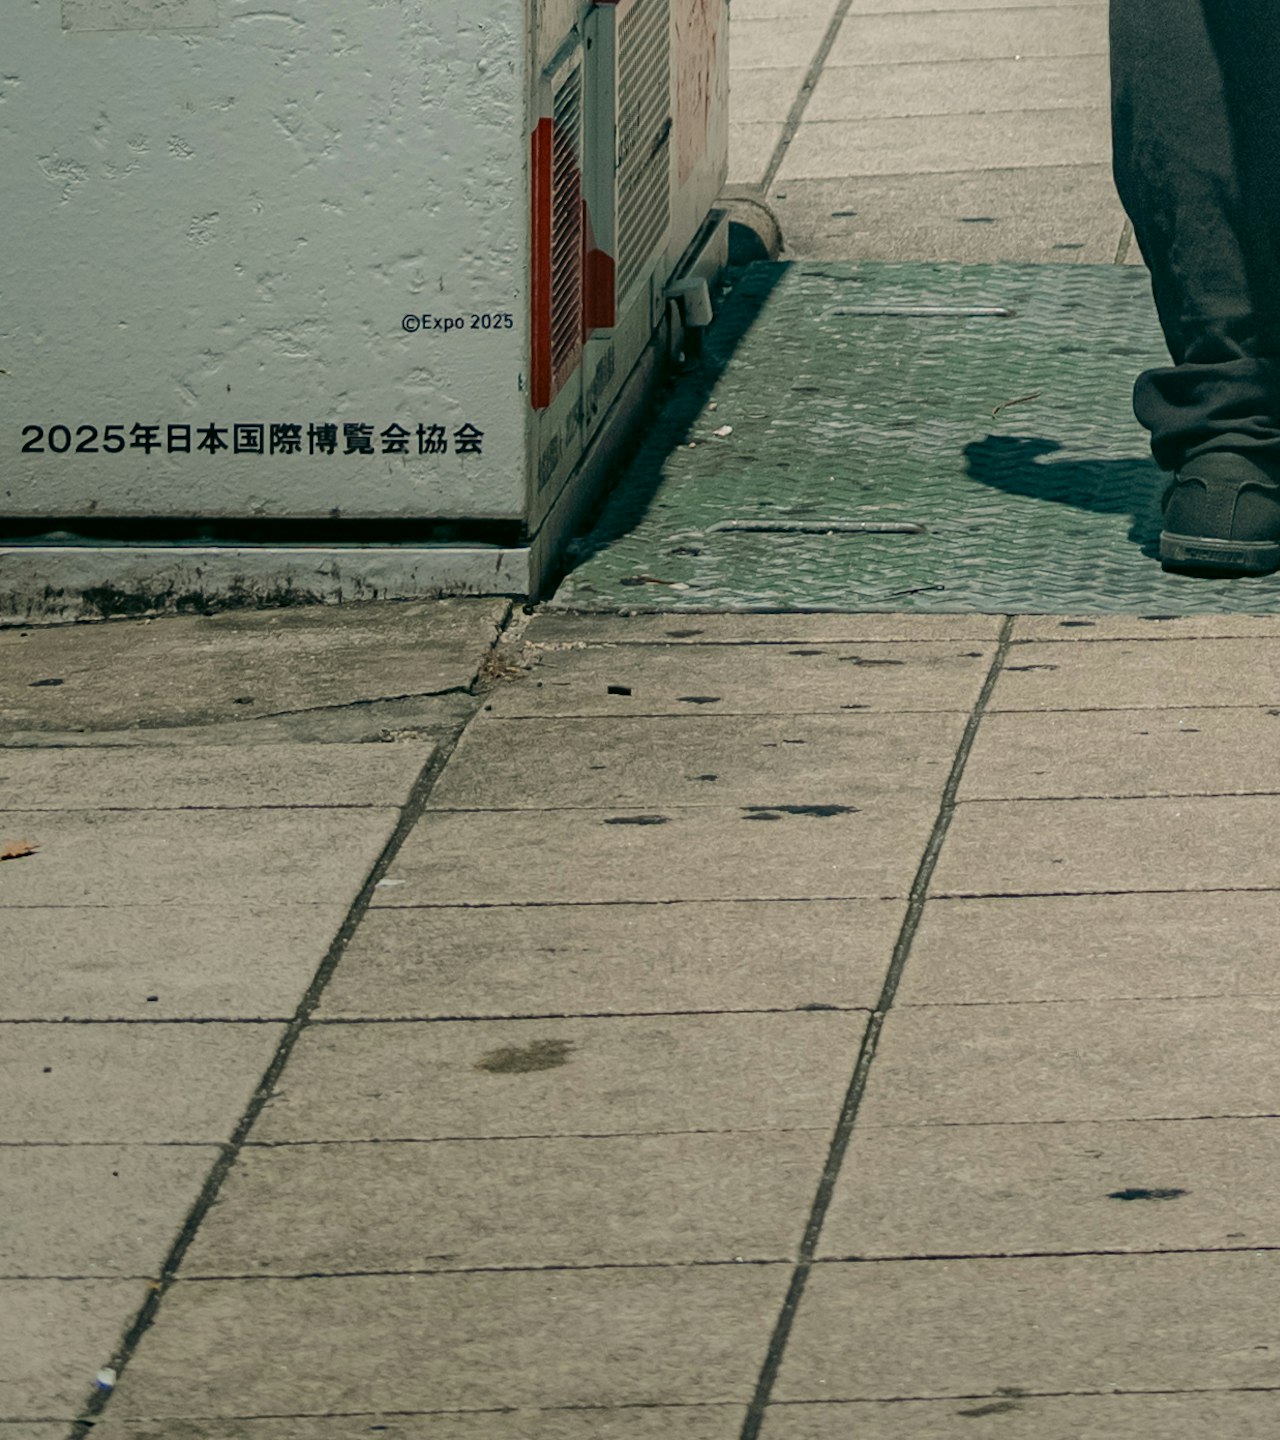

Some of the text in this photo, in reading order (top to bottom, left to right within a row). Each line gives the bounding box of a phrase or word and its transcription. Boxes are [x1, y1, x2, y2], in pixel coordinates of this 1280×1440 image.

[470, 312, 514, 330] 2025
[20, 421, 486, 456] 2025年日本国際博覧会協会
